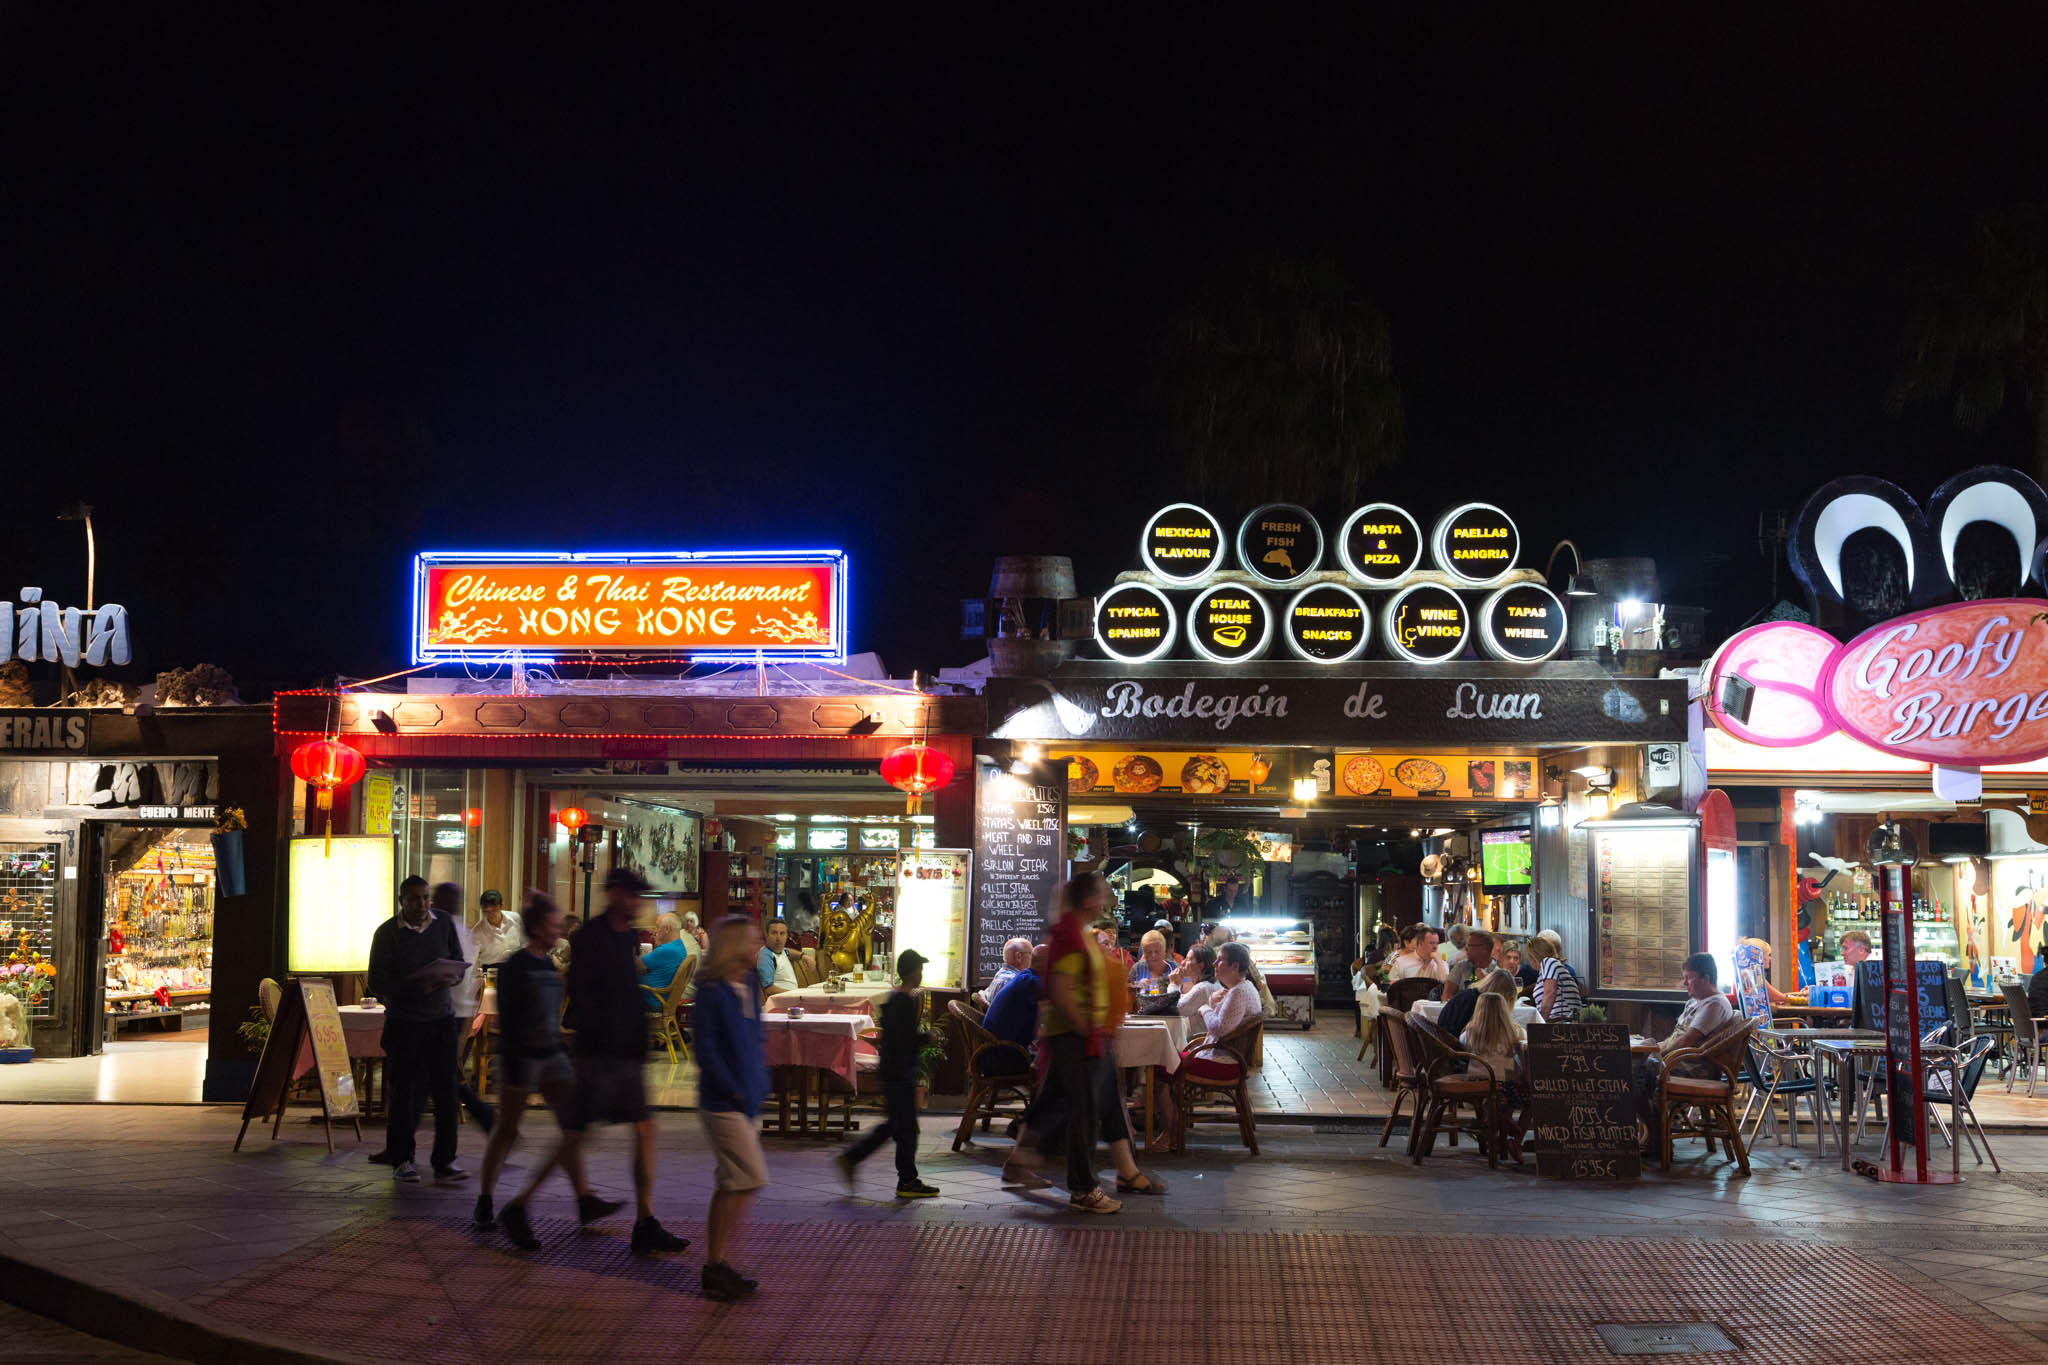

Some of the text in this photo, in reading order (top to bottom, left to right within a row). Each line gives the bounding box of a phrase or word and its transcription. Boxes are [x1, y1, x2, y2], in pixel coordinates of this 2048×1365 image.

[1155, 527, 1211, 539] MEXICAN
[1261, 521, 1301, 533] FRESH
[1363, 524, 1402, 535] PASTA
[1453, 528, 1508, 539] PAELLAS
[1266, 537, 1295, 547] FISH
[1377, 539, 1387, 549] &
[1154, 547, 1211, 559] FLAVOUR
[1364, 554, 1401, 564] PIZZA
[1453, 550, 1509, 560] SANGRIA
[445, 574, 812, 607] Chinese & Thai Restaurant
[1209, 599, 1251, 609] STEAK
[1107, 607, 1160, 618] TYPICAL
[1295, 607, 1361, 618] BREAKFAST
[1420, 609, 1458, 621] WINE
[1507, 606, 1547, 618] TAPAS
[517, 606, 737, 637] HONG KONG
[1209, 614, 1252, 624] HOUSE
[1107, 628, 1160, 639] SPANISH
[1302, 630, 1352, 641] SNACKS
[1416, 625, 1462, 638] VINOS
[1504, 627, 1548, 639] WHEEL
[1856, 616, 2025, 699] Goofy
[1101, 680, 1289, 730] Bodegón
[1343, 681, 1388, 719] de
[0, 716, 85, 749] ERALS
[140, 806, 216, 818] CUERPO MENTE
[984, 831, 1009, 844] MEAT
[1019, 858, 1049, 872] STEAK
[1009, 882, 1031, 894] STEAK
[981, 918, 1014, 931] PAELLAS
[980, 946, 1004, 957] GRILLE
